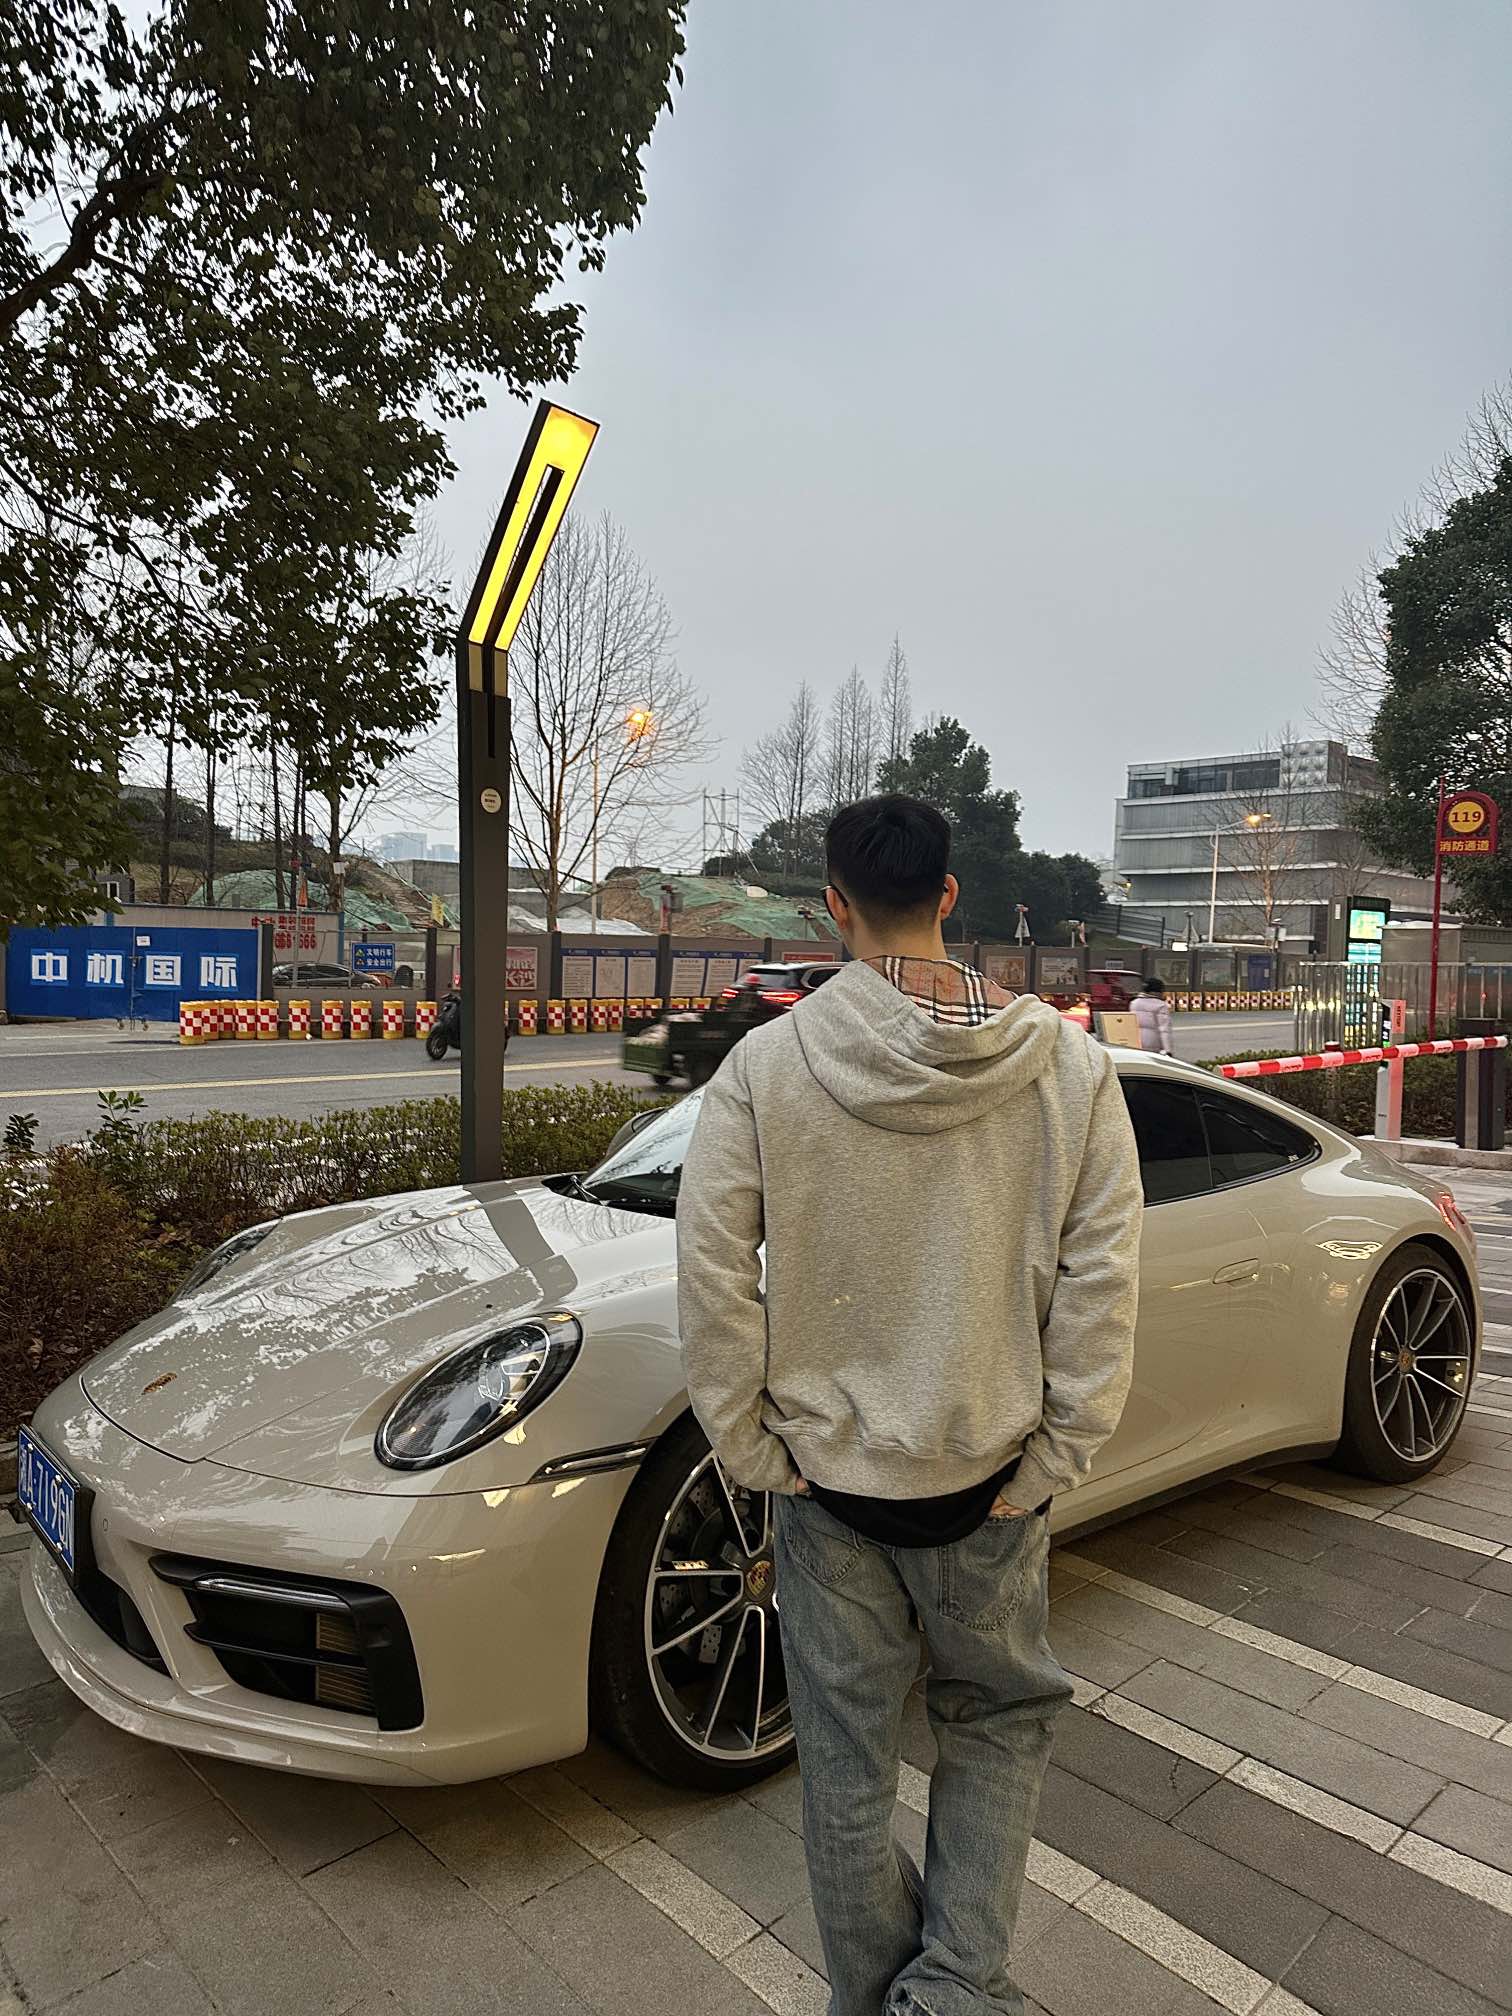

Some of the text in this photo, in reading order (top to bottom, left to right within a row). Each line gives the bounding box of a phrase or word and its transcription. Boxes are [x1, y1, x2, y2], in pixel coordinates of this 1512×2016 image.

[1451, 811, 1482, 823] 119
[1440, 840, 1490, 852] 消防通道
[31, 952, 237, 988] 中机国际
